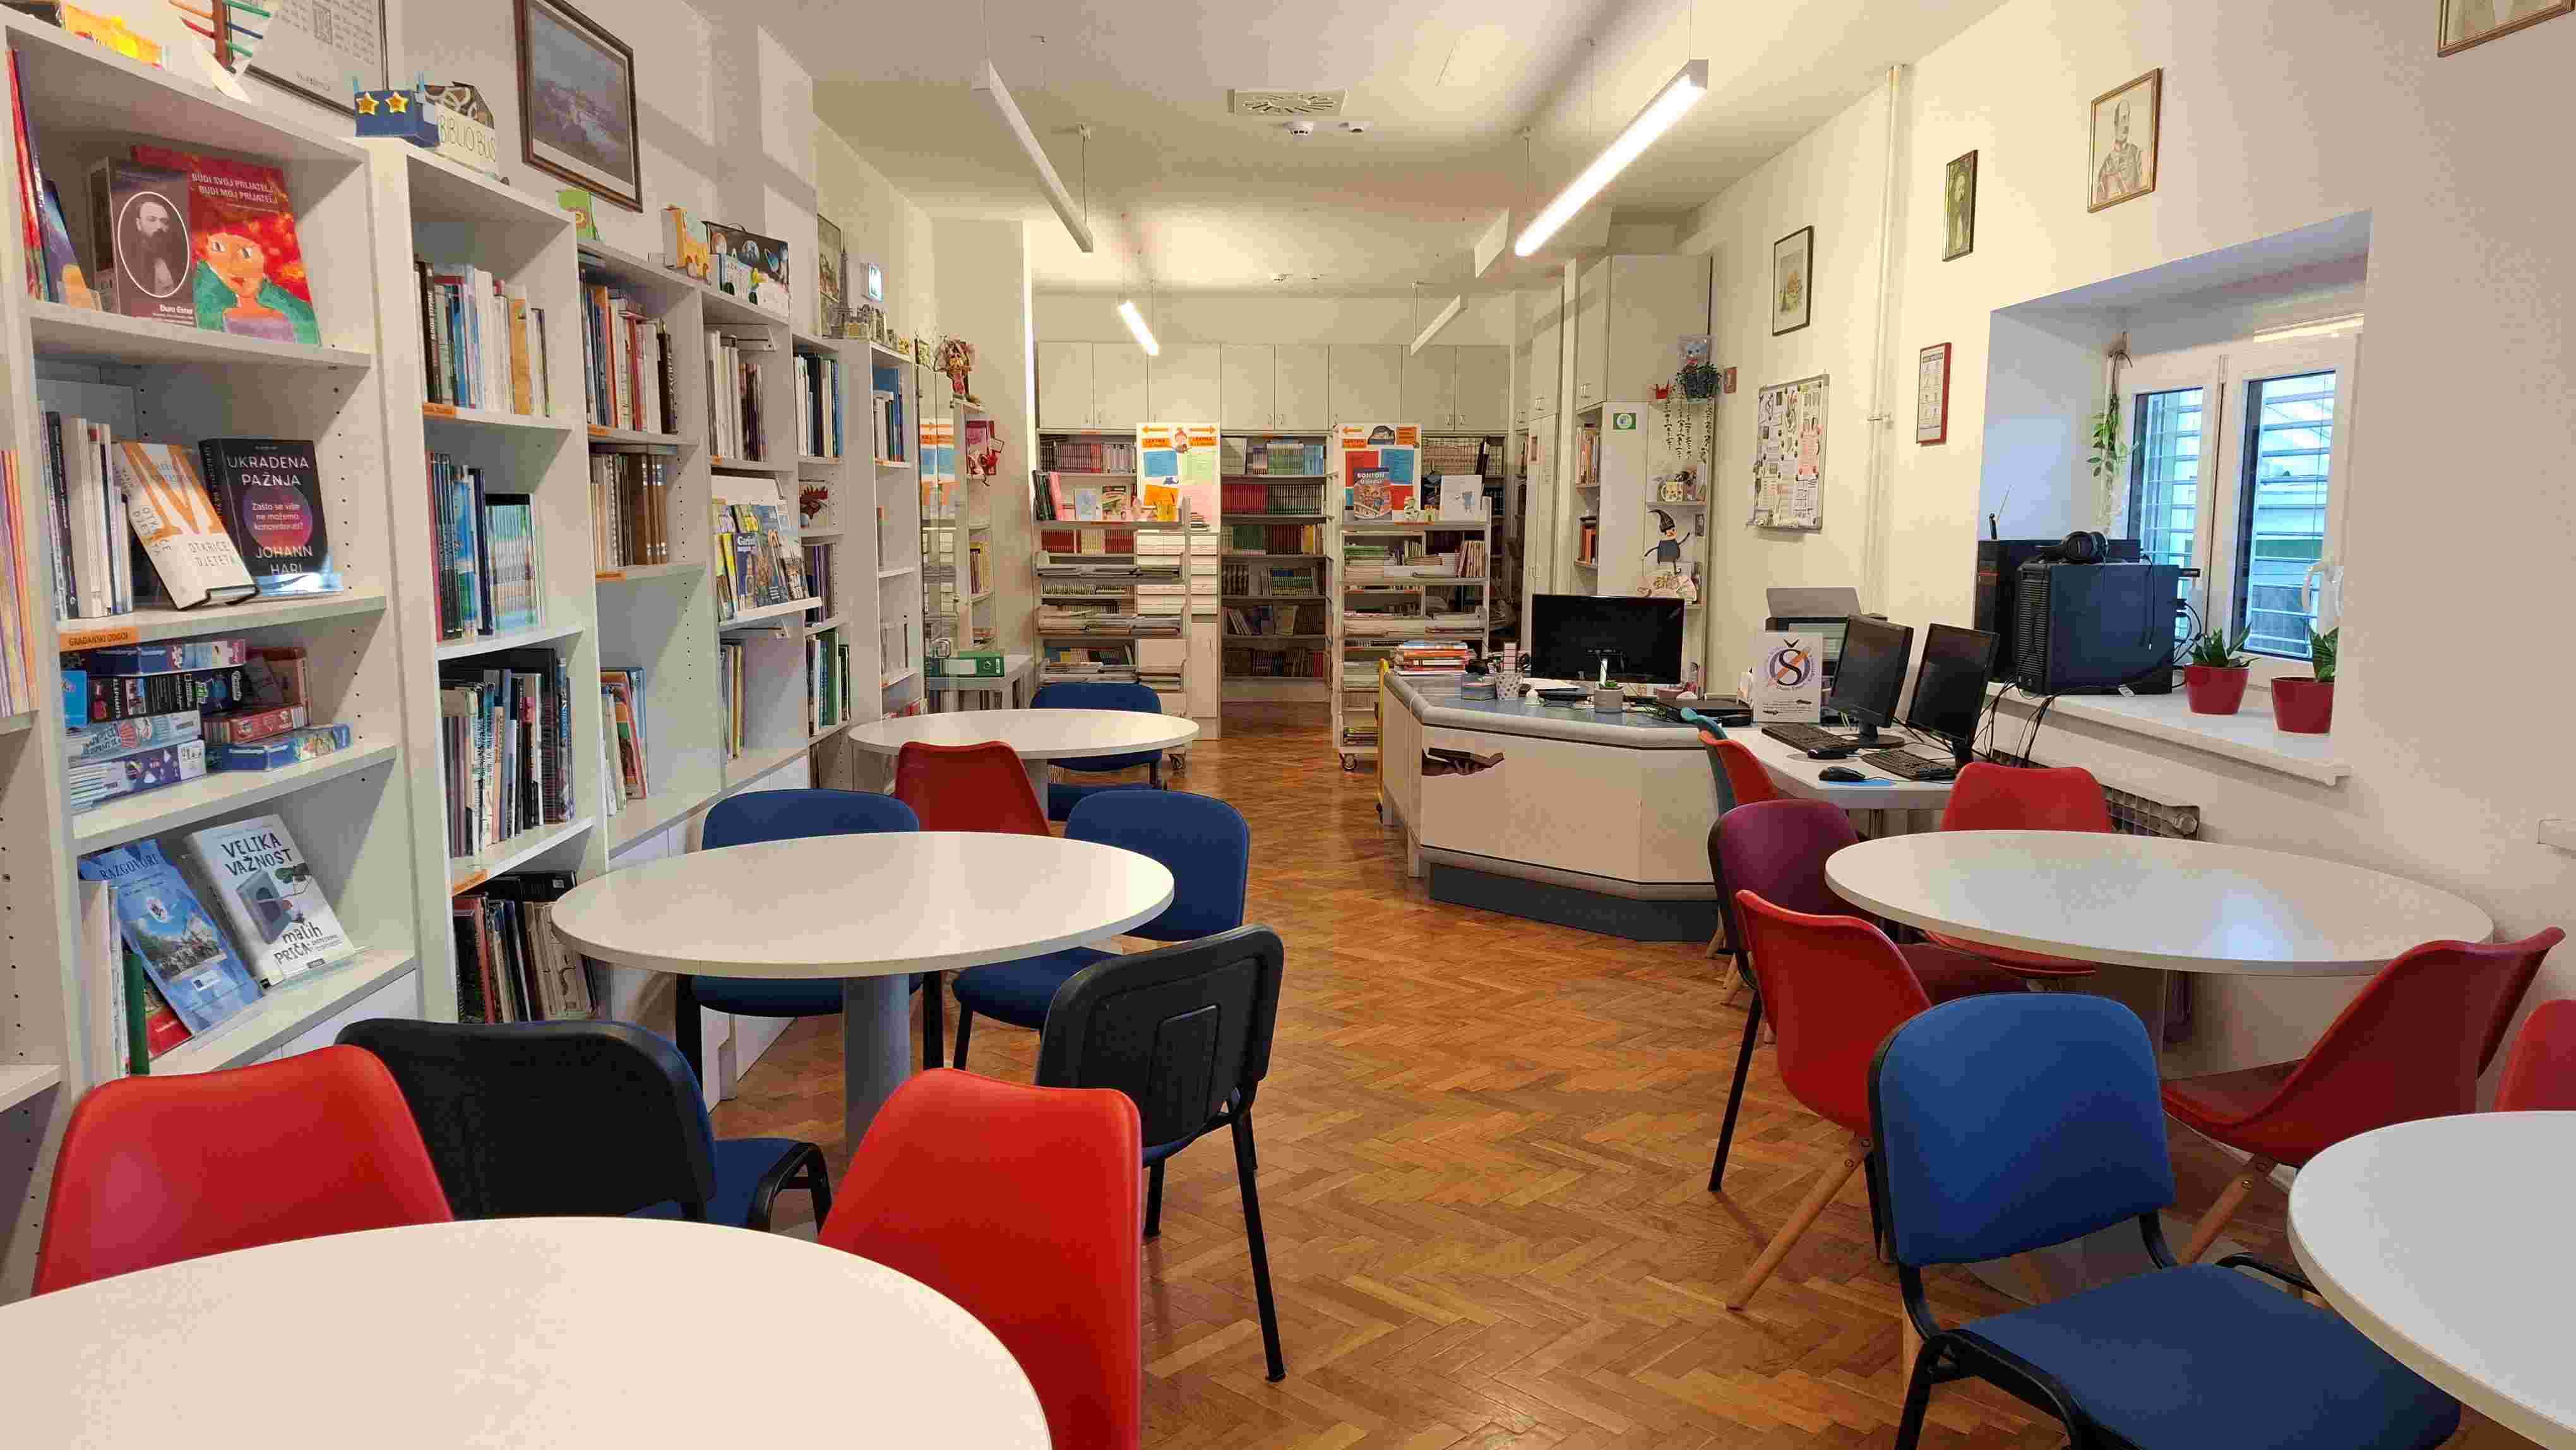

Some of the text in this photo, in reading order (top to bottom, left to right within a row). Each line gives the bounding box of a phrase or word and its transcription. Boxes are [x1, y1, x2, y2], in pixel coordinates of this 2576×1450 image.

[227, 456, 309, 469] UKRADENA
[242, 471, 302, 486] PAŽNJA
[252, 503, 273, 511] Zašto
[267, 512, 299, 520] možemo
[256, 545, 314, 558] JOHANN
[221, 832, 282, 858] VELIKA
[225, 848, 292, 876] VAŽNOST
[282, 921, 323, 944] malih
[273, 943, 313, 965] PRIČA
